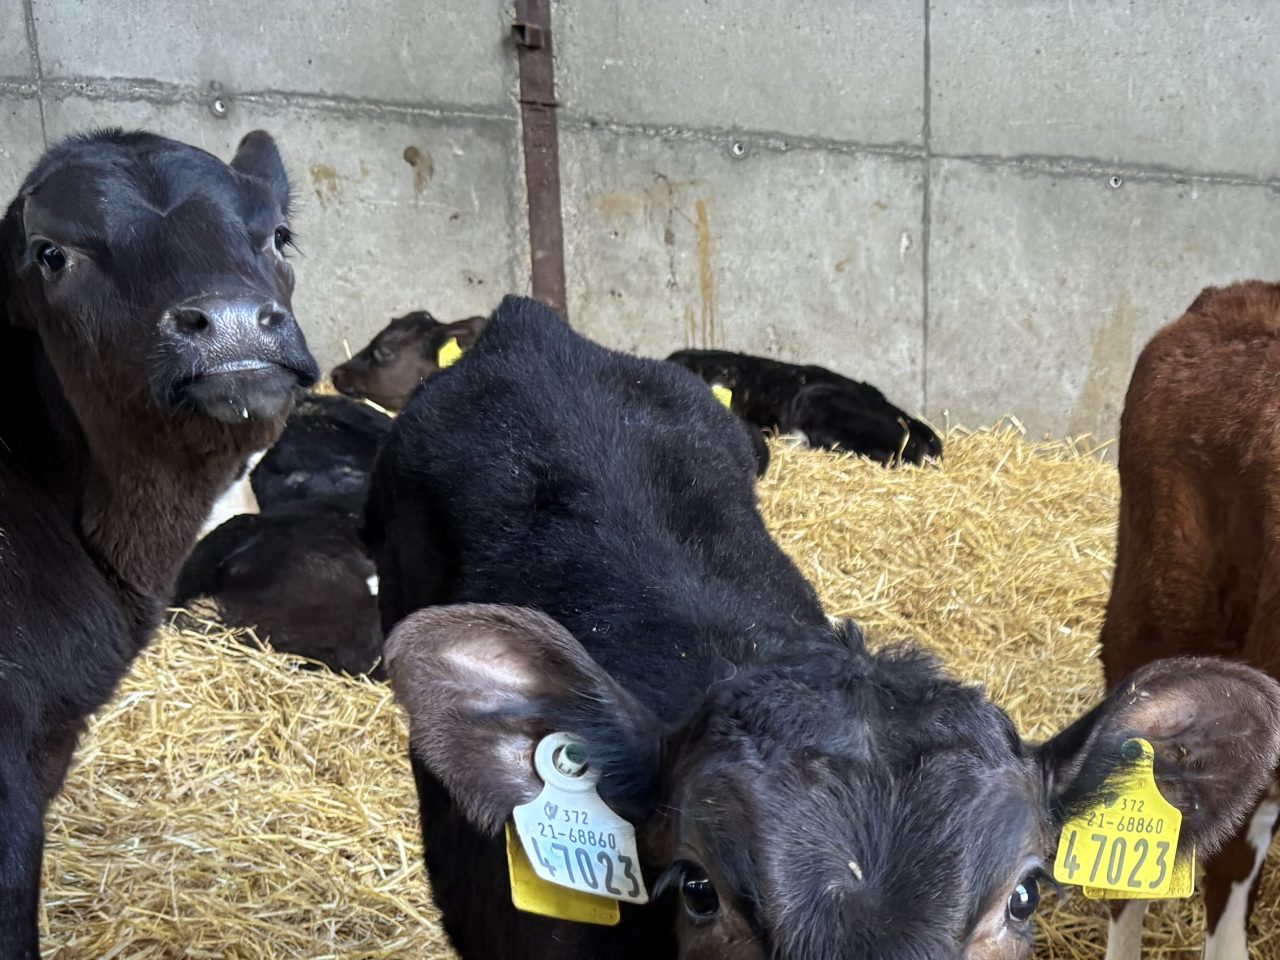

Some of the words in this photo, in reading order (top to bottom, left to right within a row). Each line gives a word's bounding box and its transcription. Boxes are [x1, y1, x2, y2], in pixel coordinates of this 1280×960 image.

[562, 809, 589, 826] 372
[1121, 798, 1145, 813] 372
[537, 822, 616, 850] 21-68860
[1087, 811, 1164, 835] 21-68860
[531, 837, 640, 898] 47023
[1063, 830, 1170, 889] 47023
